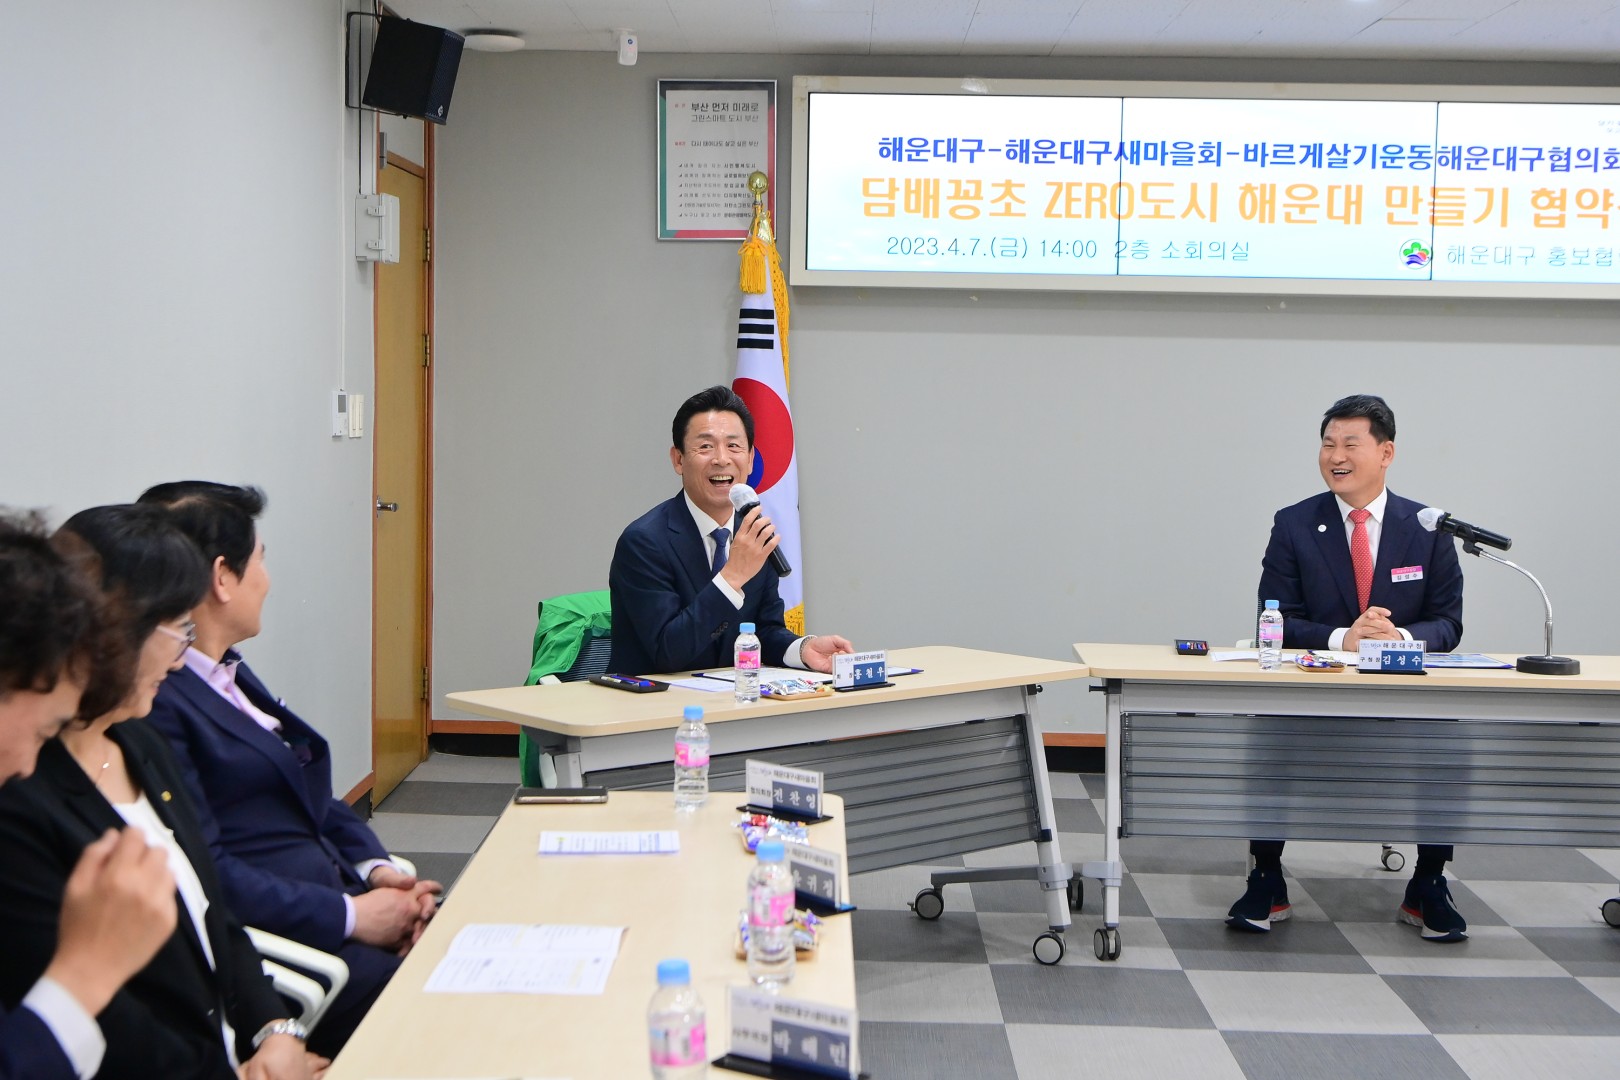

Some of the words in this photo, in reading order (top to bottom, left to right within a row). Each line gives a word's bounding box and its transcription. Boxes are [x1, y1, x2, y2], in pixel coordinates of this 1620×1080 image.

[691, 102, 709, 113] 부산
[712, 102, 731, 113] 먼저
[733, 102, 760, 113] 미래로
[862, 177, 1027, 221] 담배꽁초
[1044, 180, 1218, 223] ZERO도시
[1238, 182, 1364, 226] 해운대
[1384, 184, 1510, 228] 만들기
[1529, 187, 1620, 230] 협약
[886, 236, 1028, 260] 2023.4.7.(금)
[1040, 238, 1098, 260] 14:00
[1114, 239, 1151, 261] 2층
[1160, 240, 1250, 262] 소회의실
[1446, 244, 1536, 267] 해운대구
[1547, 246, 1620, 268] 홍보협
[1382, 654, 1422, 666] 김성수
